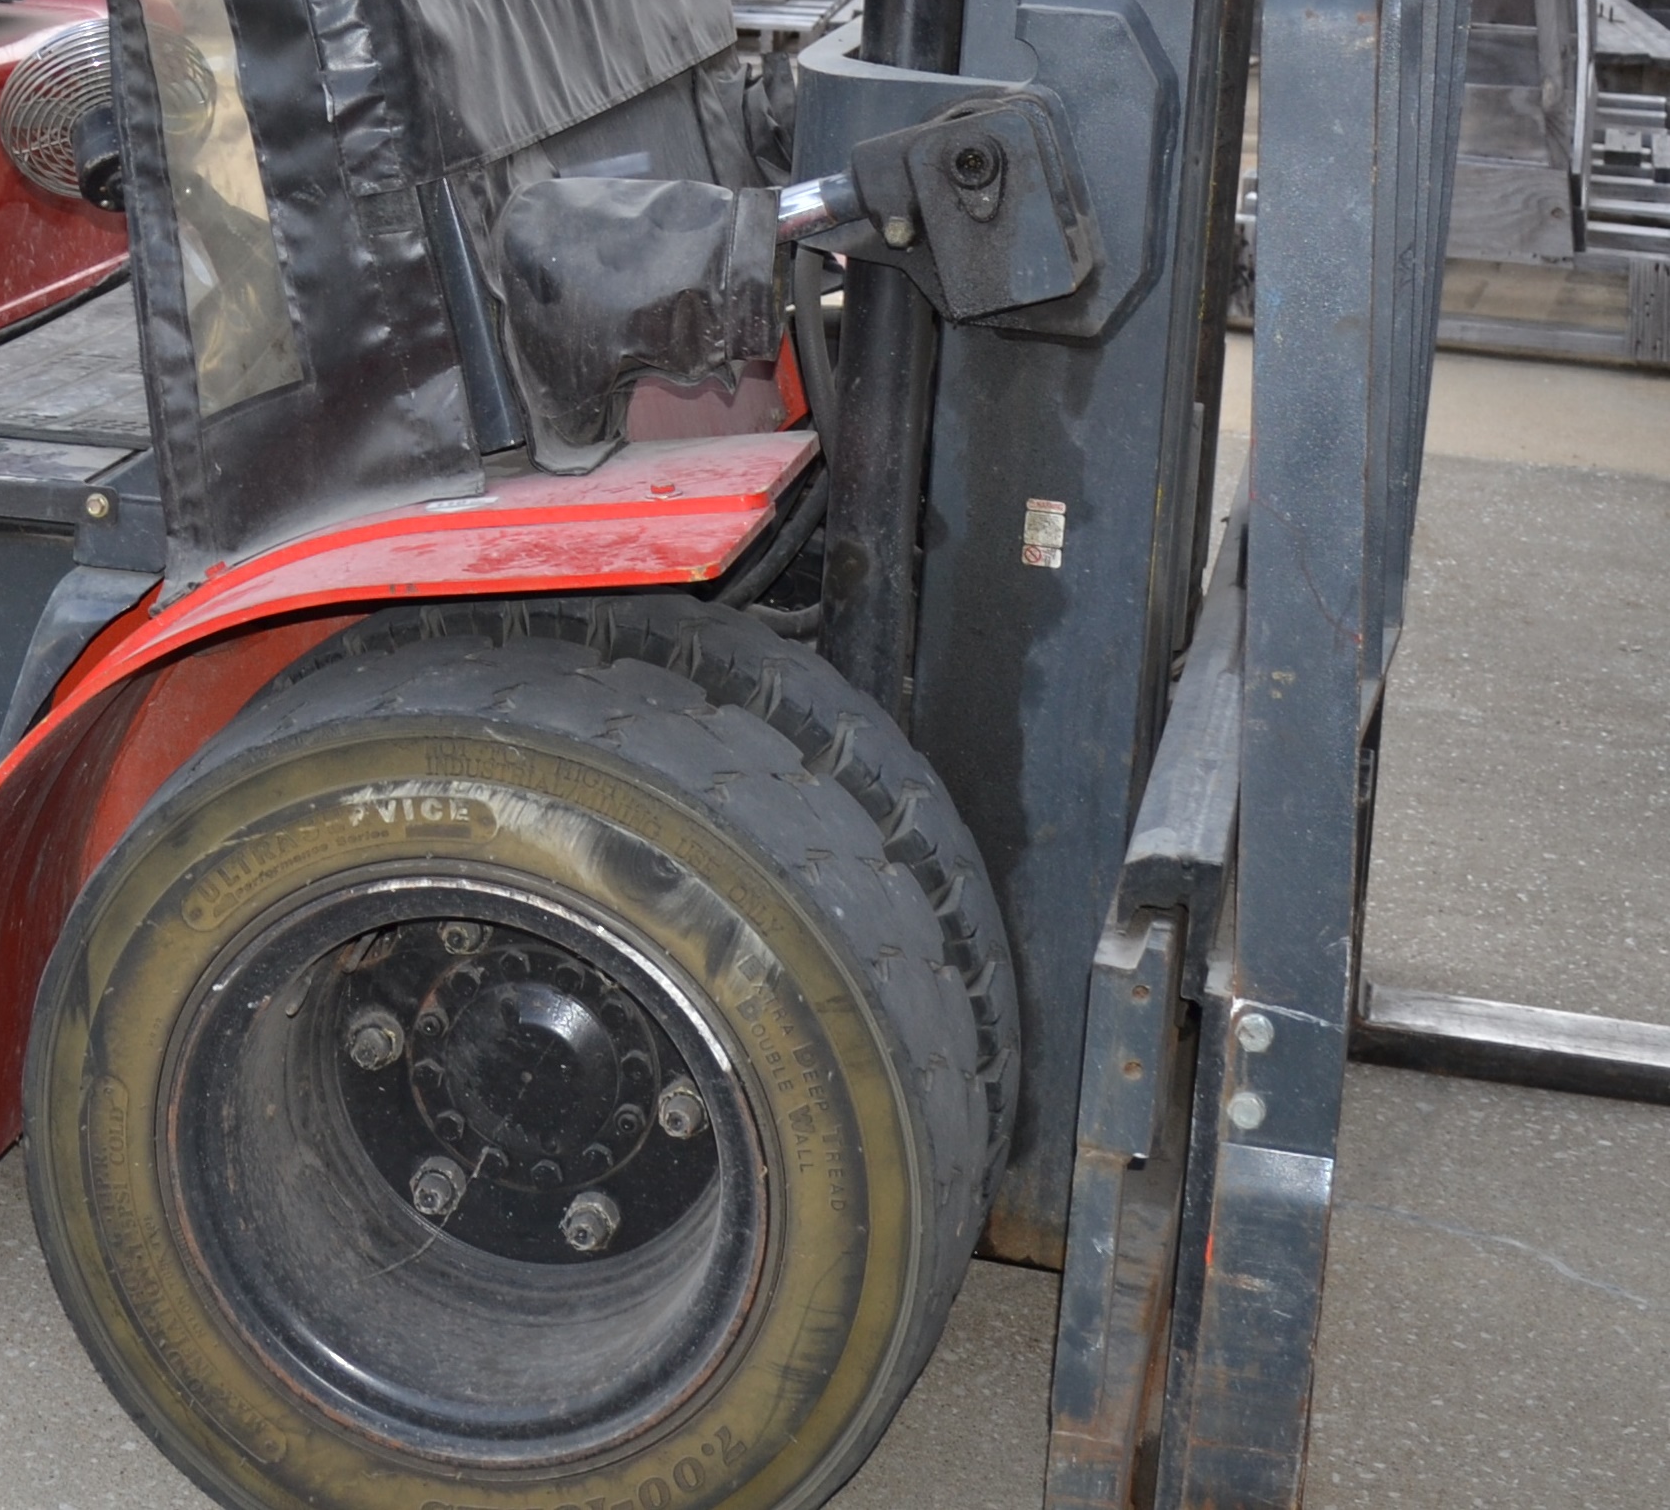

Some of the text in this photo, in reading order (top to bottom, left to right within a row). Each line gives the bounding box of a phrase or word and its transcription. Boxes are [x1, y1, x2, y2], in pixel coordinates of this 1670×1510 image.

[728, 884, 786, 938] ONLY
[108, 1105, 125, 1166] COLD
[735, 995, 816, 1174] DOUBLE WALL
[791, 1041, 831, 1113] DEEP
[820, 1125, 847, 1213] TREAD
